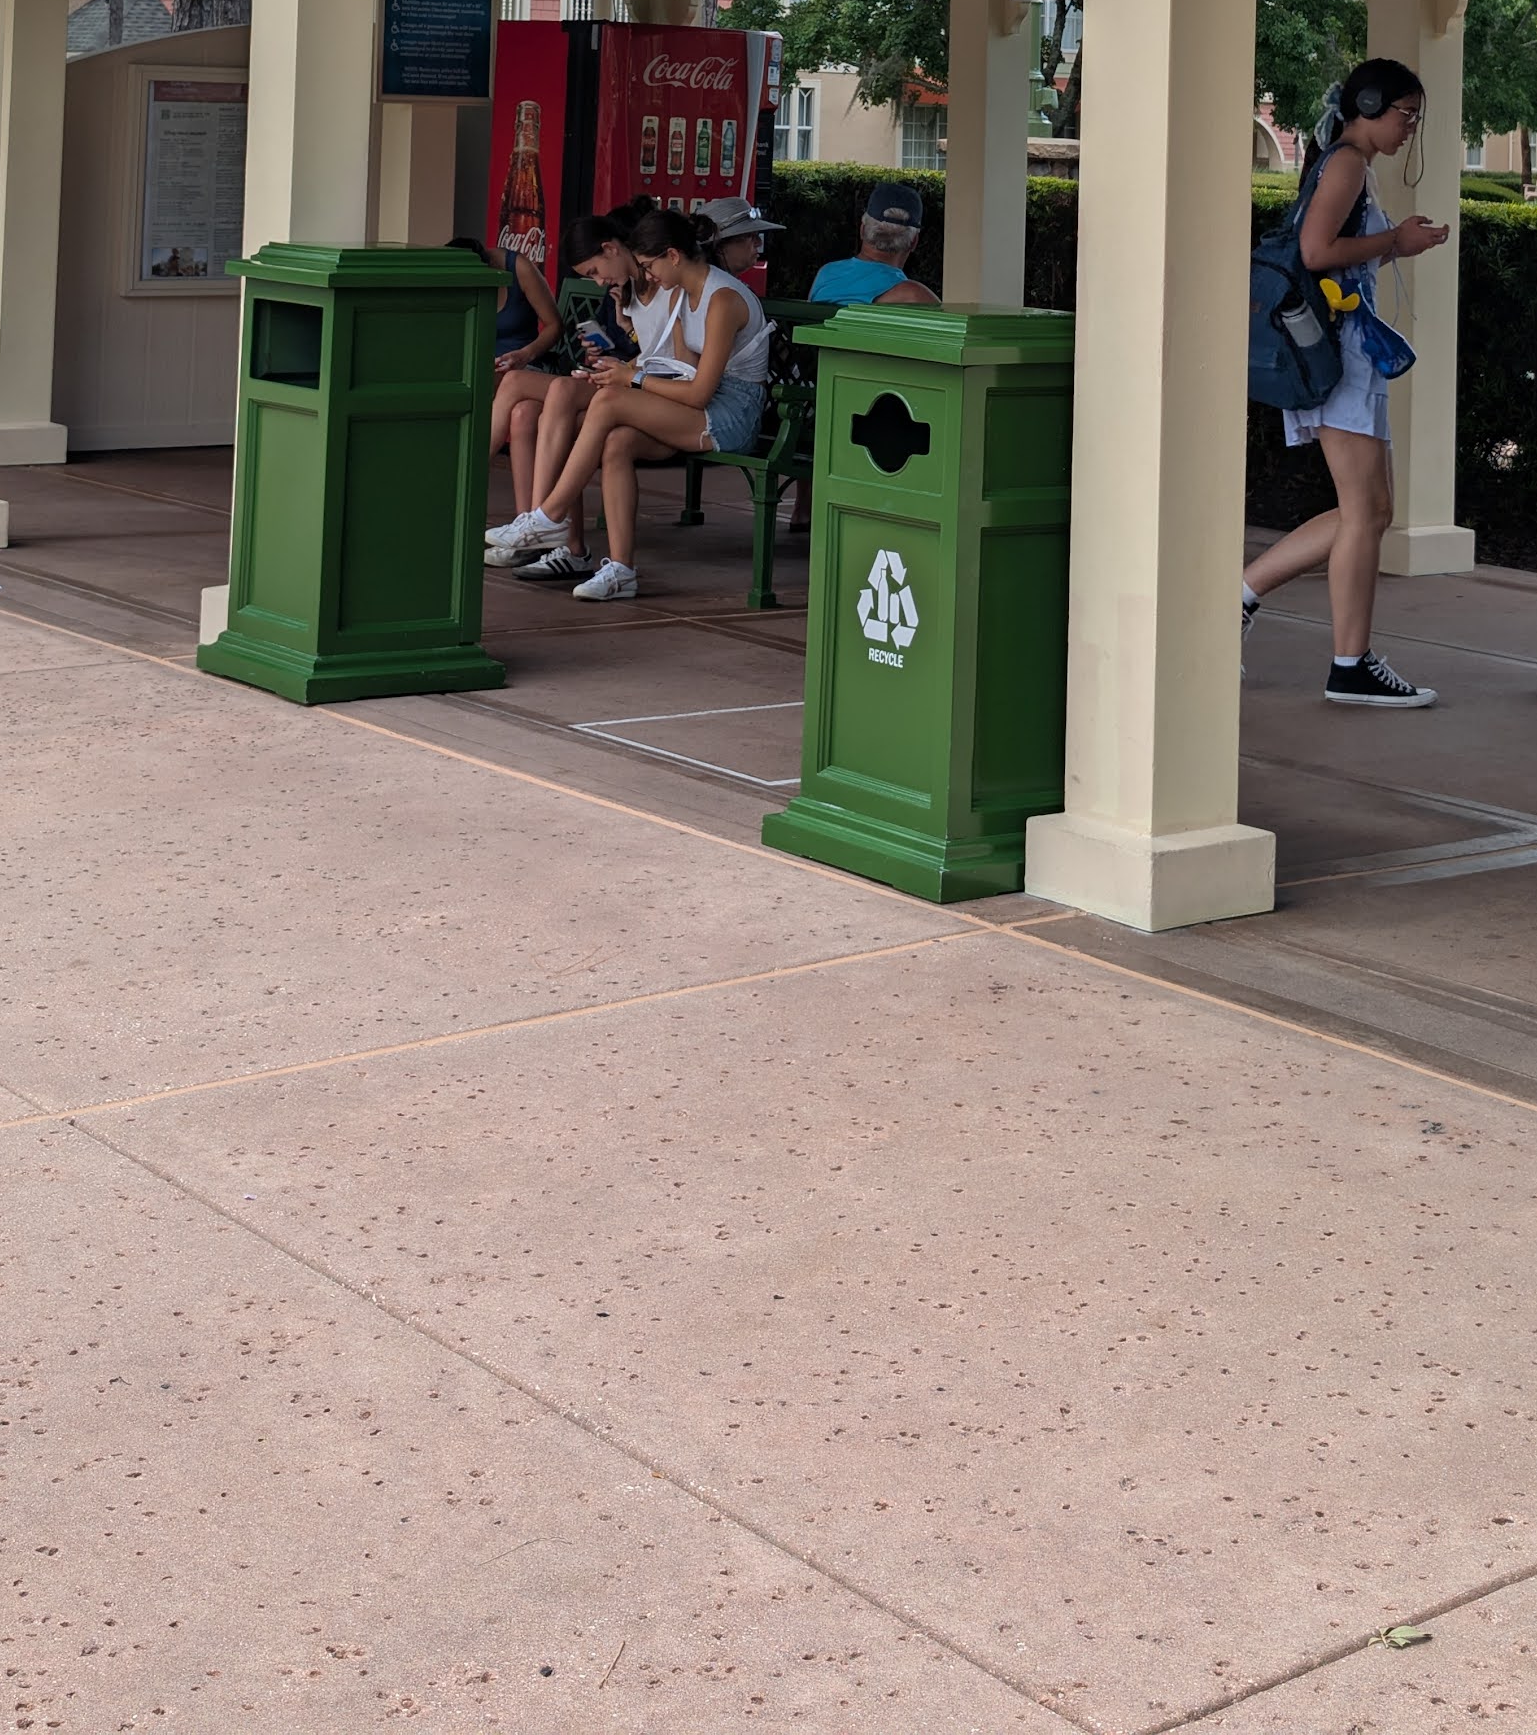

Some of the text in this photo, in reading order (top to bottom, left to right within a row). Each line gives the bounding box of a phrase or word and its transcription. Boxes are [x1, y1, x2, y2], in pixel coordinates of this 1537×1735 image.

[642, 53, 739, 90] Coca-Cola
[497, 224, 546, 263] Coca-Cola
[868, 647, 904, 669] RECYCLE
